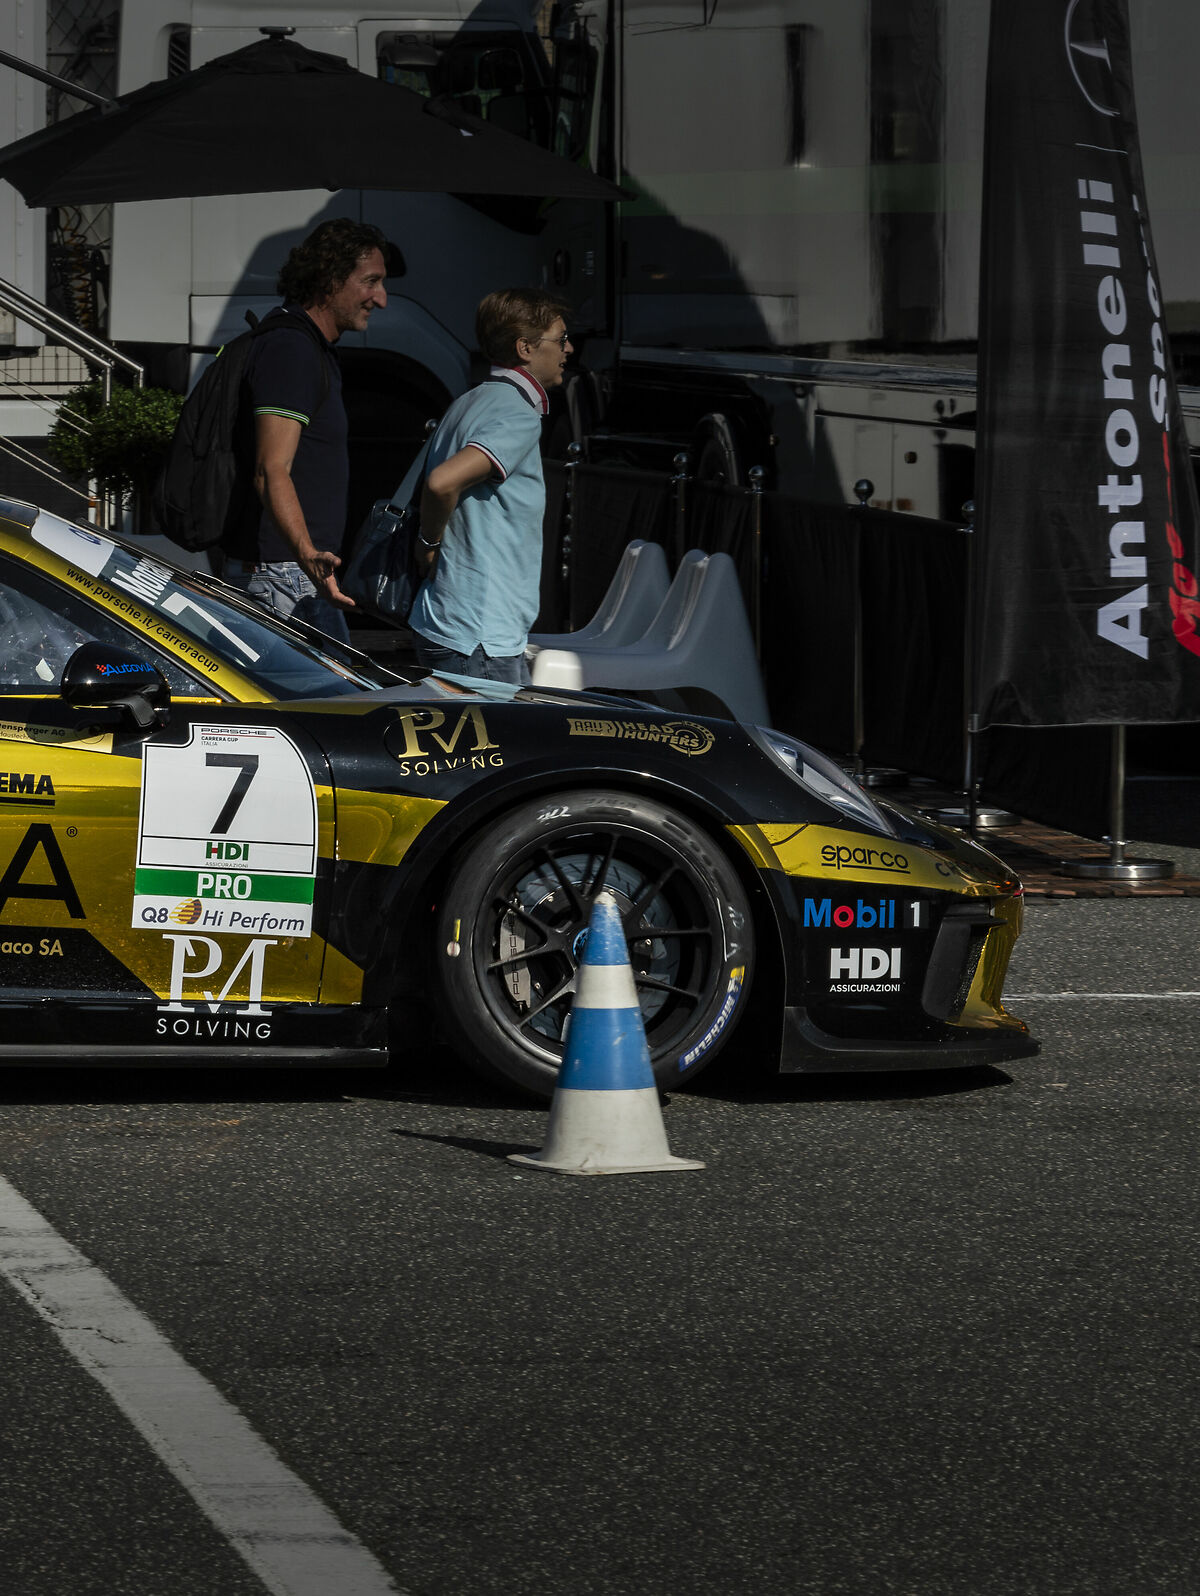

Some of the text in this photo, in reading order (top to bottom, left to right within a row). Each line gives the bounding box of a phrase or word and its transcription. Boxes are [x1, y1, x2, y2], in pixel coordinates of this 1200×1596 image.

[1076, 178, 1150, 660] Antonelli
[66, 567, 220, 674] www.porsche.it/carreracup
[160, 591, 261, 663] 7
[51, 728, 66, 737] AG
[200, 727, 268, 736] PORSCHE
[621, 721, 675, 735] HEAD
[623, 730, 700, 748] HUNTERS
[200, 740, 218, 748] ITALIA
[205, 752, 259, 835] 7
[205, 841, 250, 861] HDI
[821, 845, 909, 869] sparco
[204, 861, 249, 869] ASSICURAZIONI
[196, 873, 253, 899] PRO
[141, 906, 305, 933] Q8 Hi Perform
[803, 897, 921, 929] Mobil 1
[38, 938, 64, 957] SA
[829, 947, 902, 980] HDI
[829, 983, 901, 993] ASSICURAZIONI
[156, 1017, 272, 1039] SOLVING
[684, 994, 736, 1066] MICHELIN
